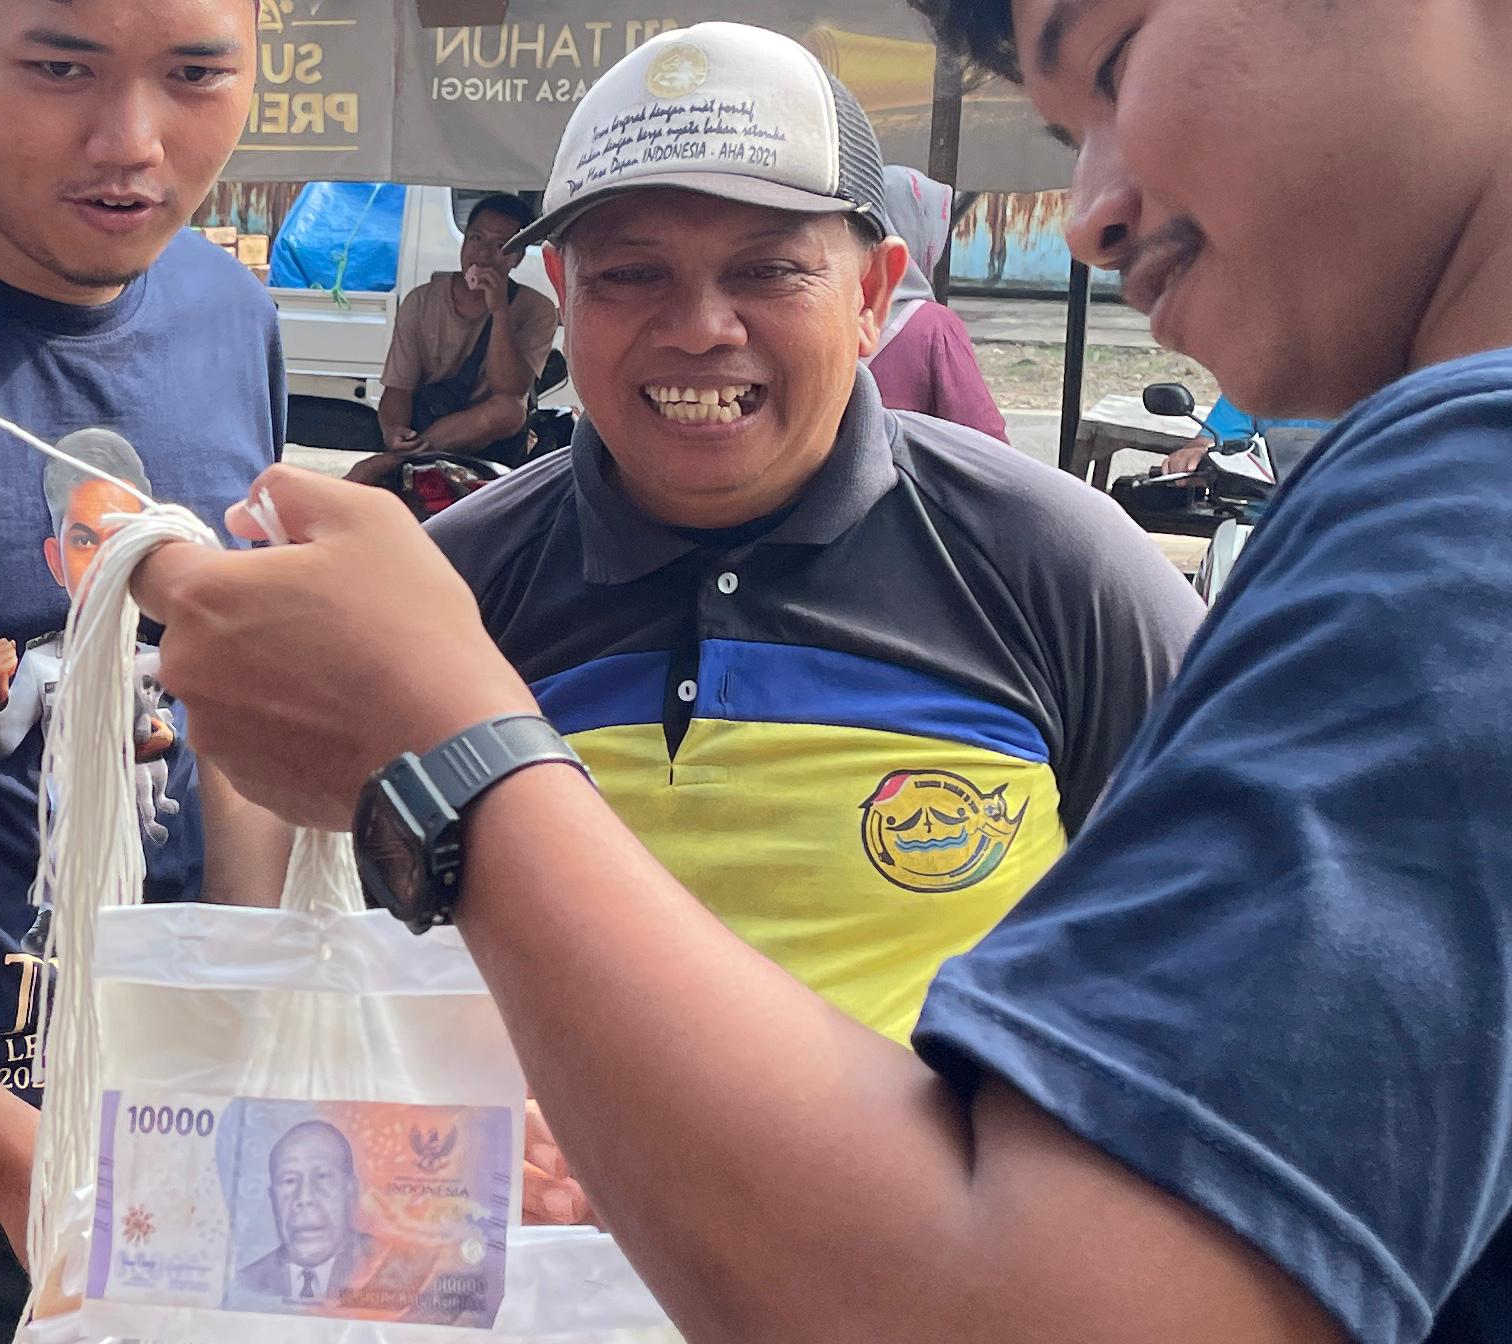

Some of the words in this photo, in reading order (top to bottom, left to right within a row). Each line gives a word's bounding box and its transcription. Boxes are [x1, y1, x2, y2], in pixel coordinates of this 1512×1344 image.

[642, 141, 706, 164] INDONESIA
[717, 141, 745, 160] AHA
[127, 1105, 215, 1137] 10000
